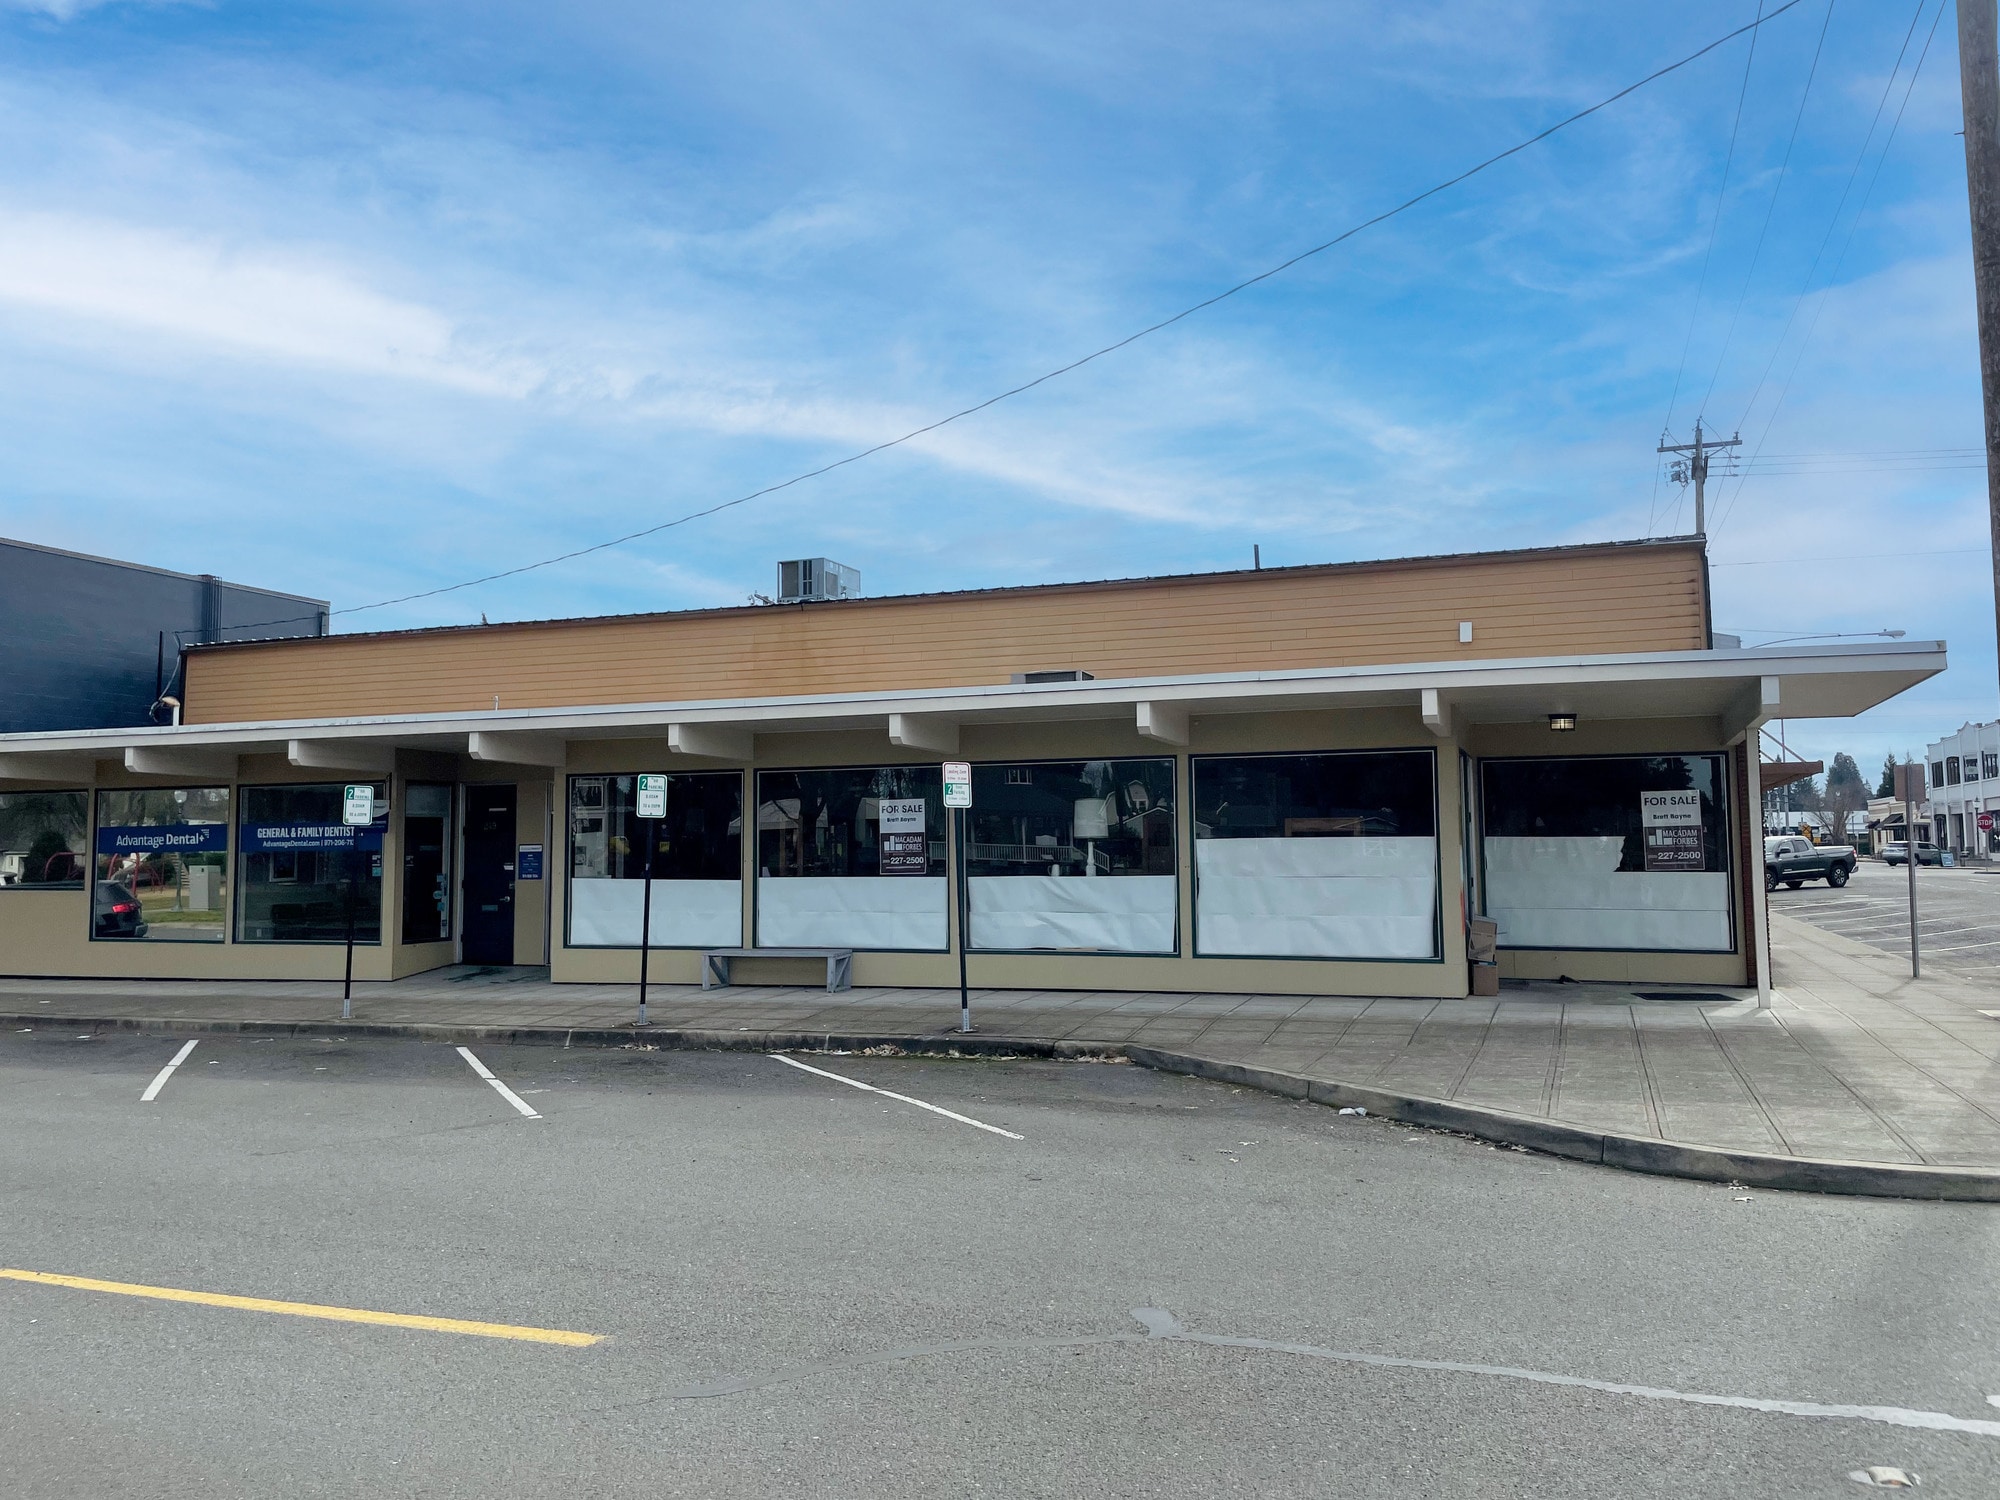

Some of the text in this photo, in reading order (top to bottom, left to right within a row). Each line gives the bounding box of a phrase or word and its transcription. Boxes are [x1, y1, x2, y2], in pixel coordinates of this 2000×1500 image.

[642, 779, 647, 790] 2
[948, 784, 953, 794] 2
[348, 789, 354, 799] 2
[1644, 796, 1697, 806] FOR SALE
[881, 804, 923, 814] FOR SALE
[257, 826, 363, 839] GENERAL & FAMILY DENTIST
[1662, 829, 1698, 837] MACADAM
[116, 834, 165, 849] Advantage
[895, 835, 923, 843] MACADAM
[1673, 837, 1698, 845] FORBES
[890, 856, 925, 865] 227-2500
[1657, 851, 1701, 860] 227-2500
